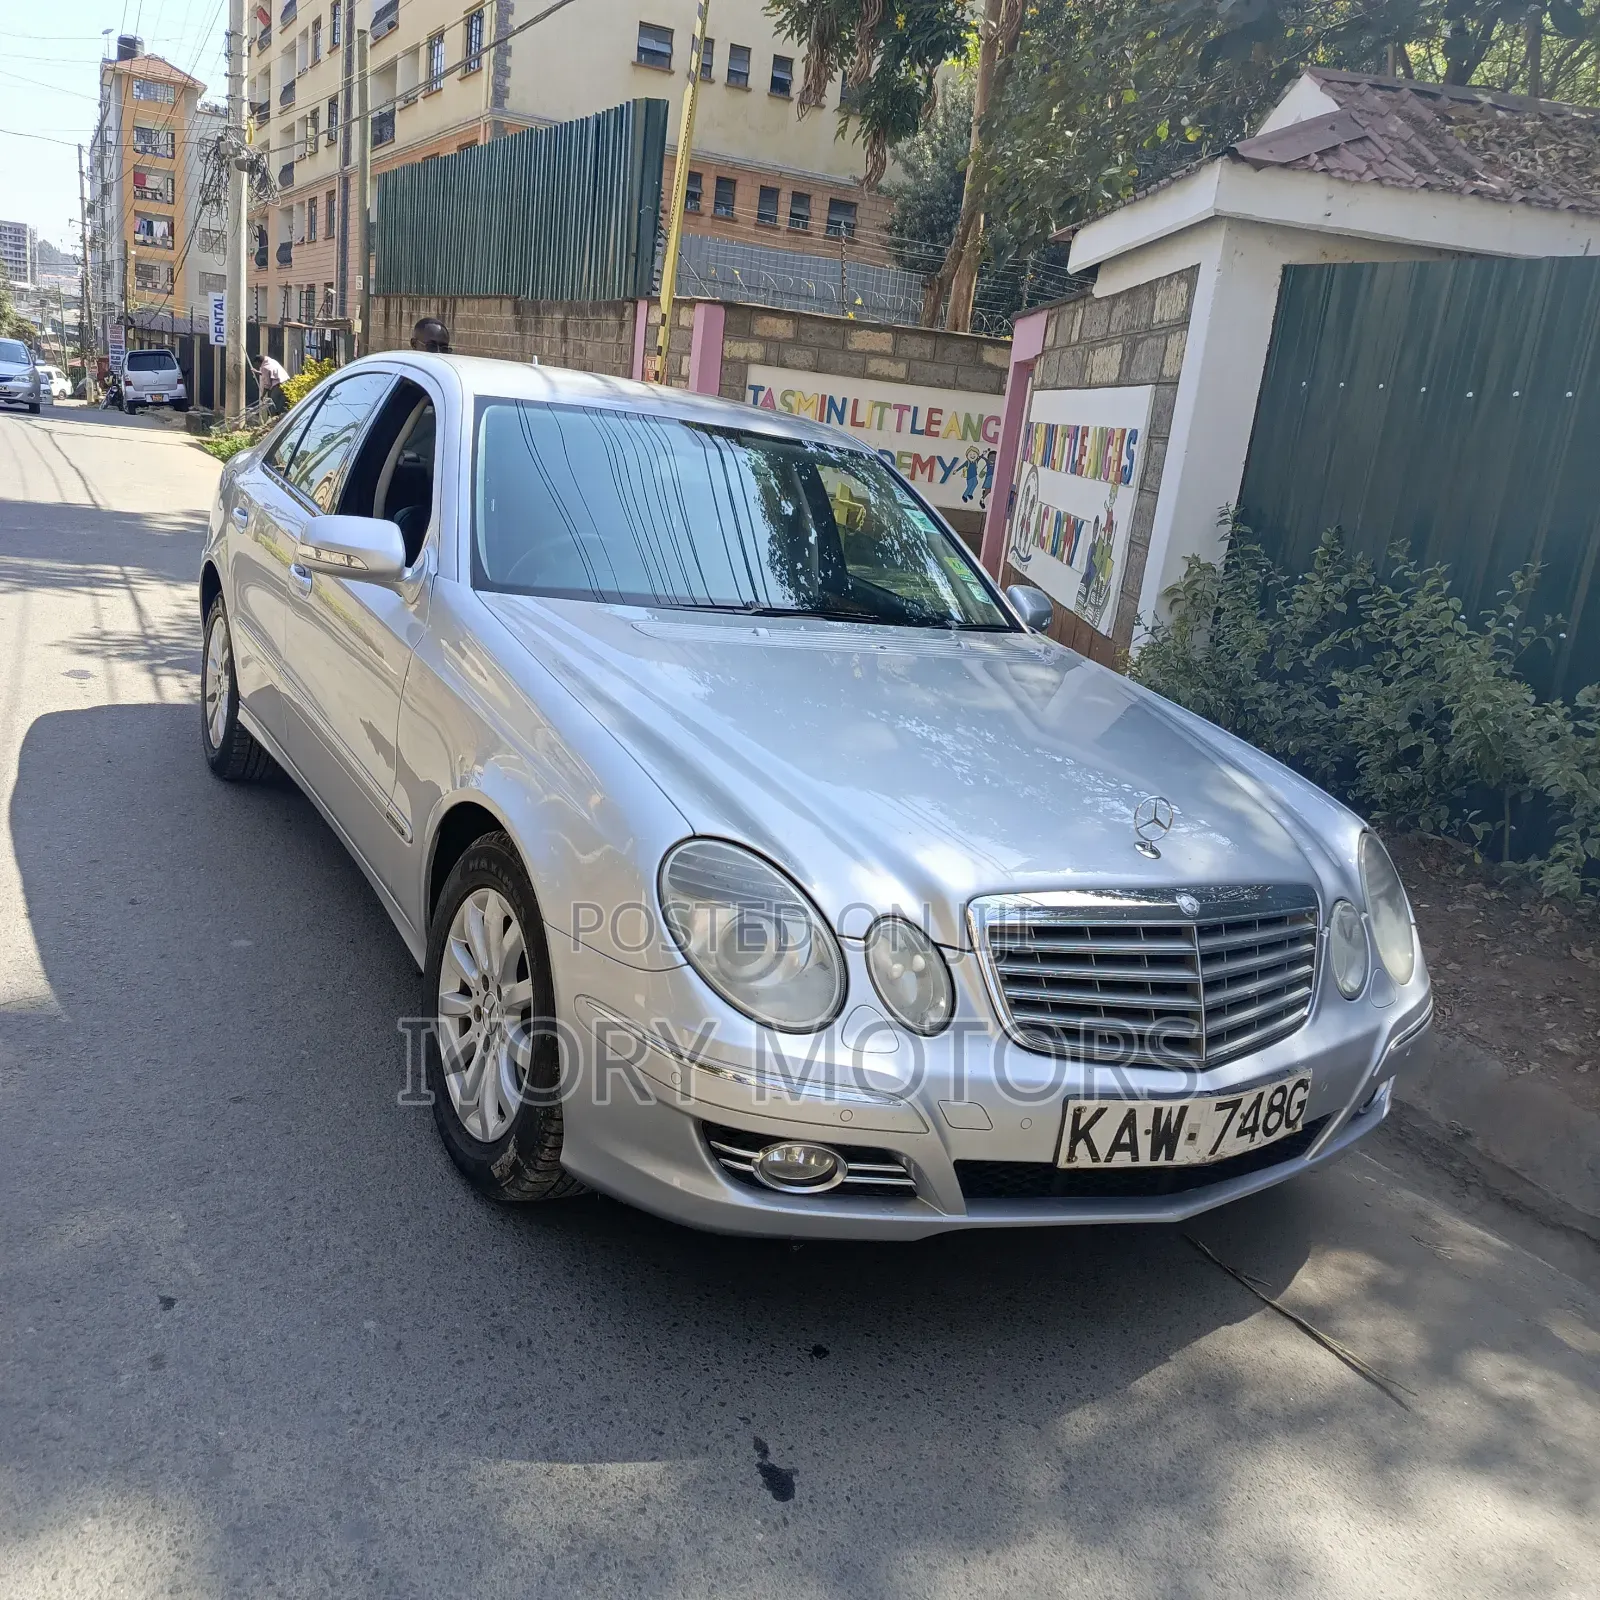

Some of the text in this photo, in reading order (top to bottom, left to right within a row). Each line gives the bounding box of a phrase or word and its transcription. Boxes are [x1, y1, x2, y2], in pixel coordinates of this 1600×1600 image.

[213, 296, 224, 343] DENTAL
[748, 385, 847, 426] TASMIN
[850, 398, 943, 437] LITTLE
[1032, 503, 1086, 567] ACADEMY
[1068, 1078, 1310, 1164] KAW 748G
